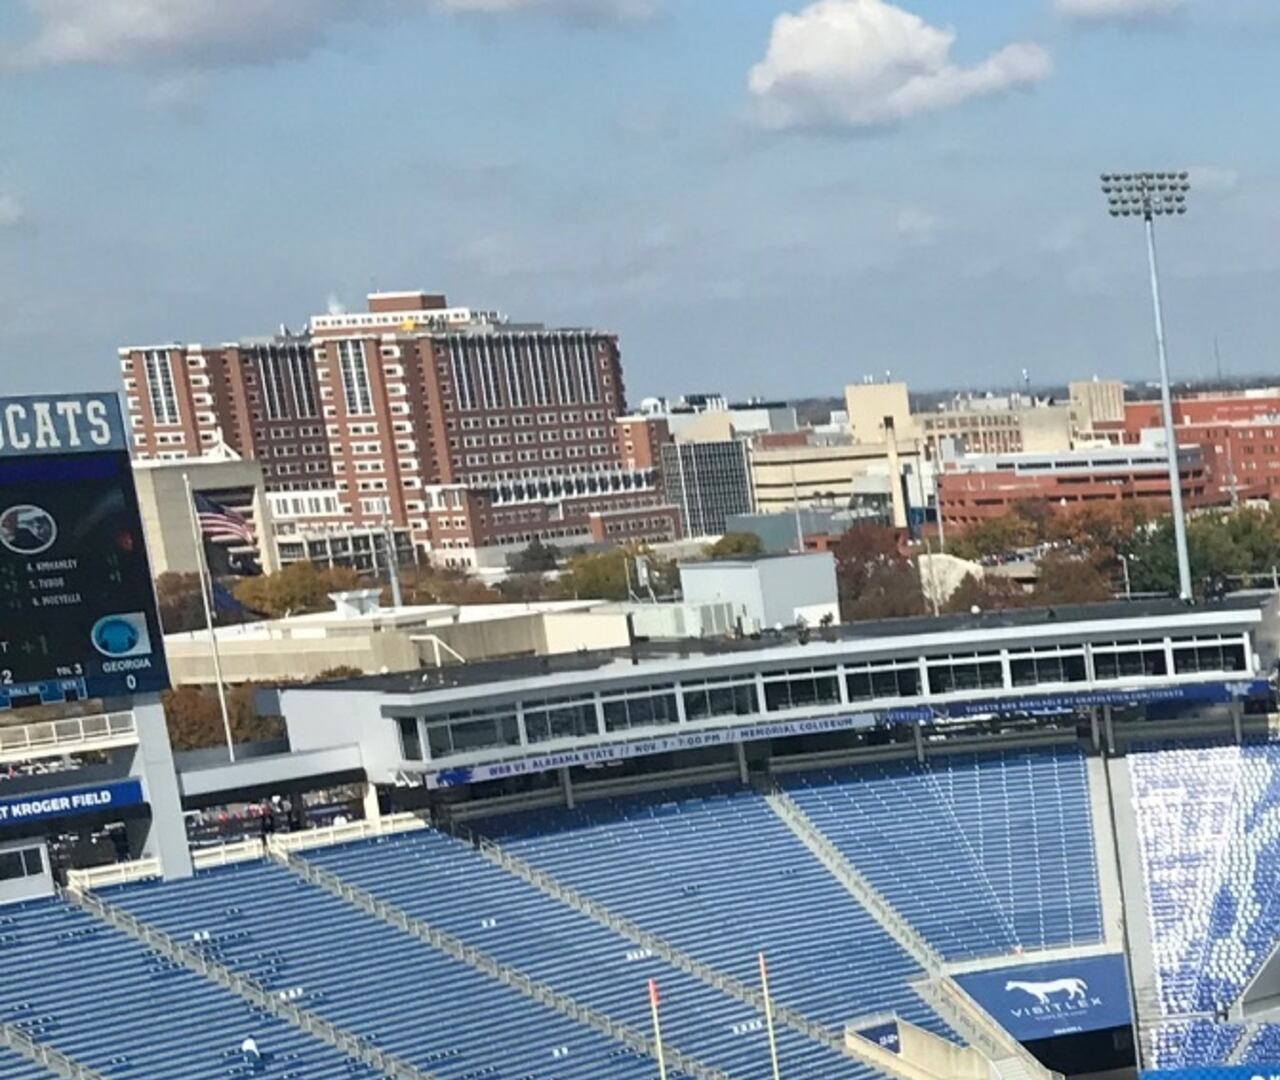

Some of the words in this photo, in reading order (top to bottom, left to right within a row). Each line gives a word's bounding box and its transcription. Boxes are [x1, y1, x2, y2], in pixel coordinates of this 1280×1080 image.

[0, 400, 111, 449] CATS
[102, 658, 152, 673] GEORGIA
[126, 675, 136, 689] 0
[12, 797, 70, 818] KROGER
[74, 790, 111, 806] FIELD
